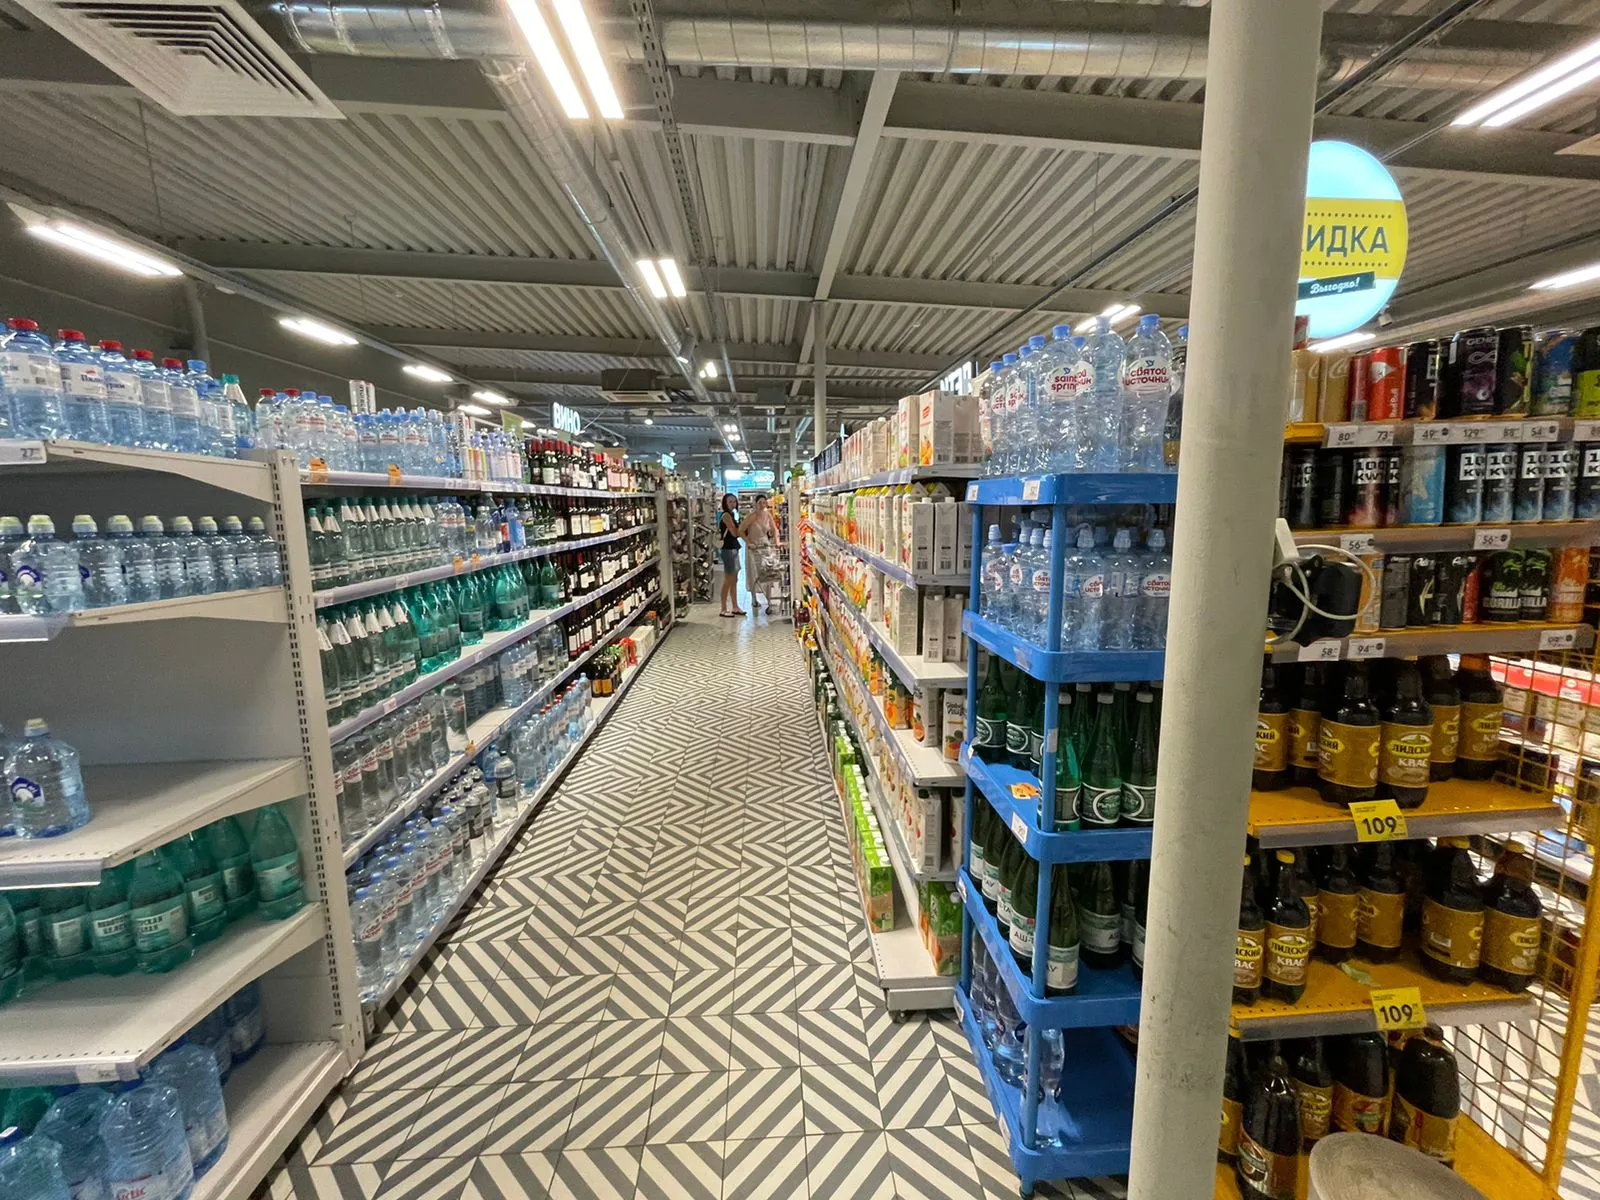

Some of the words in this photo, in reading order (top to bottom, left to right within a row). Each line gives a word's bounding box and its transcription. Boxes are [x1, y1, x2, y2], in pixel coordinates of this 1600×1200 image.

[1306, 224, 1389, 257] ИДКА
[1310, 276, 1361, 294] Выгодно!
[1054, 373, 1077, 384] saint
[1051, 382, 1078, 393] sprin
[553, 401, 581, 436] ВИНО
[1377, 430, 1389, 440] 73
[1463, 428, 1480, 438] 129
[1464, 456, 1486, 466] 10
[1349, 541, 1361, 550] 56
[1481, 535, 1494, 545] 56
[1358, 645, 1370, 654] 94
[1362, 816, 1397, 835] 109
[1014, 931, 1035, 945] АШ-Т
[1234, 959, 1256, 970] ВАС
[1380, 1004, 1413, 1024] 109
